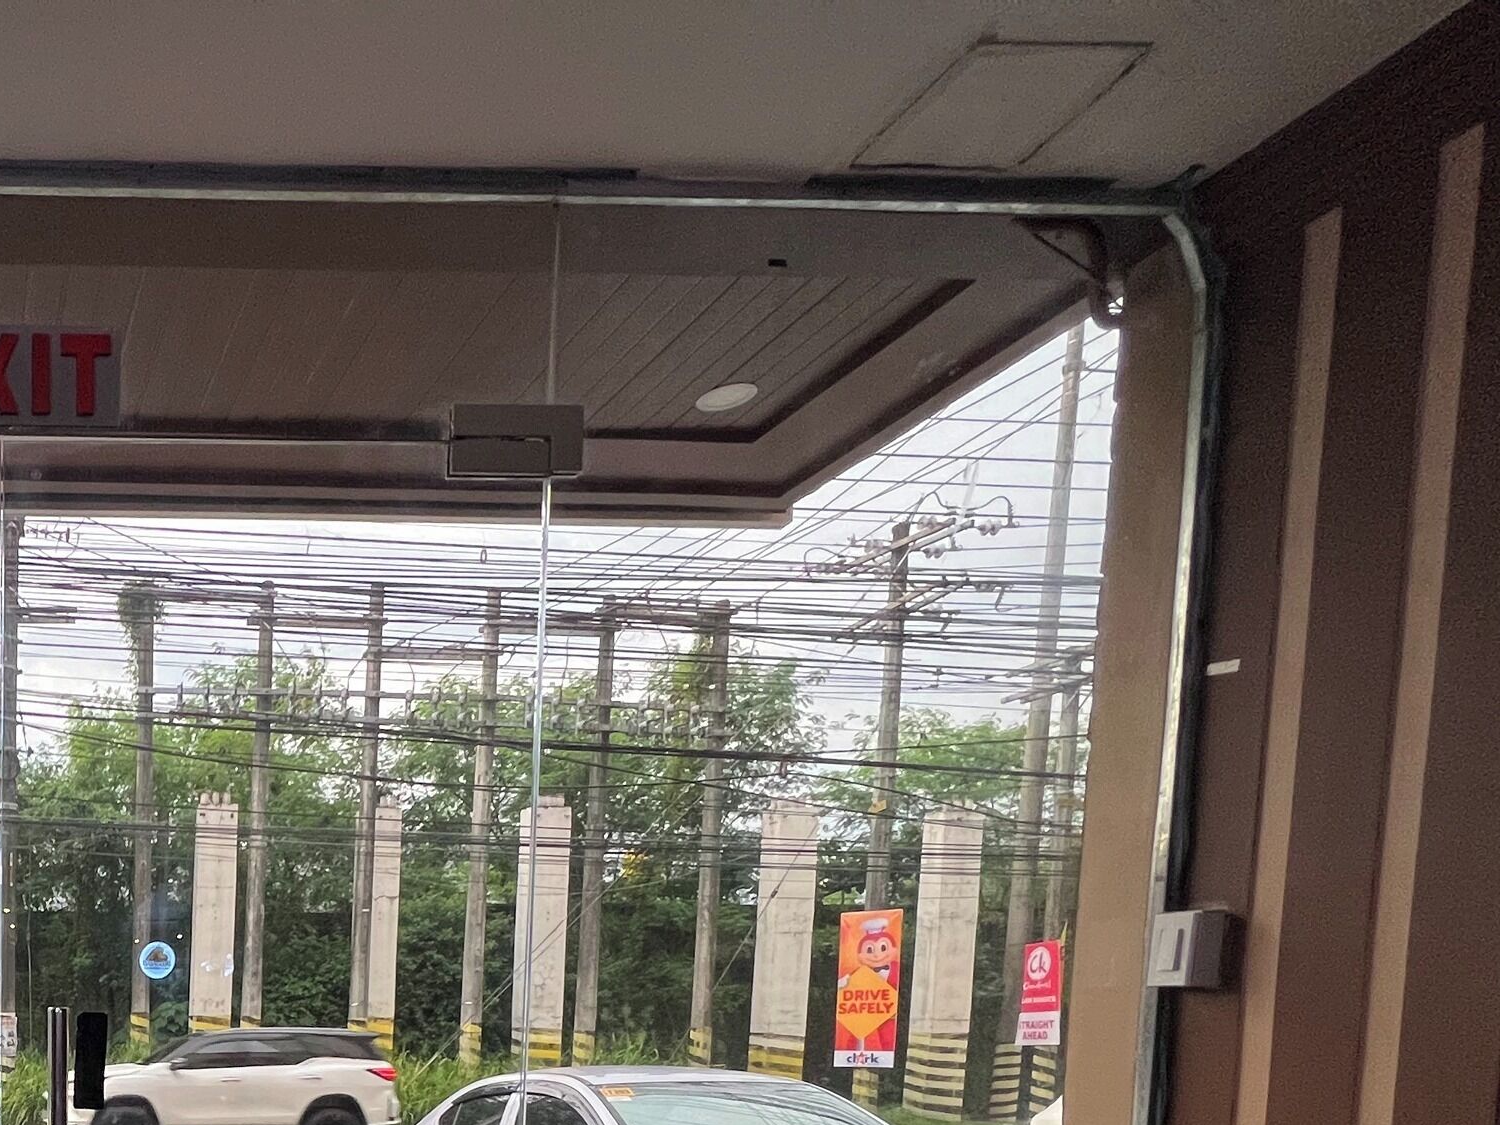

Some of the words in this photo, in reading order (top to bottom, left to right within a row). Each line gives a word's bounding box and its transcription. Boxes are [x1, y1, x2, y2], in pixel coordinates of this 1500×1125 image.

[843, 989, 890, 1002] DRIVE
[838, 1002, 894, 1015] SAFELY
[1022, 1031, 1048, 1041] AHEAD
